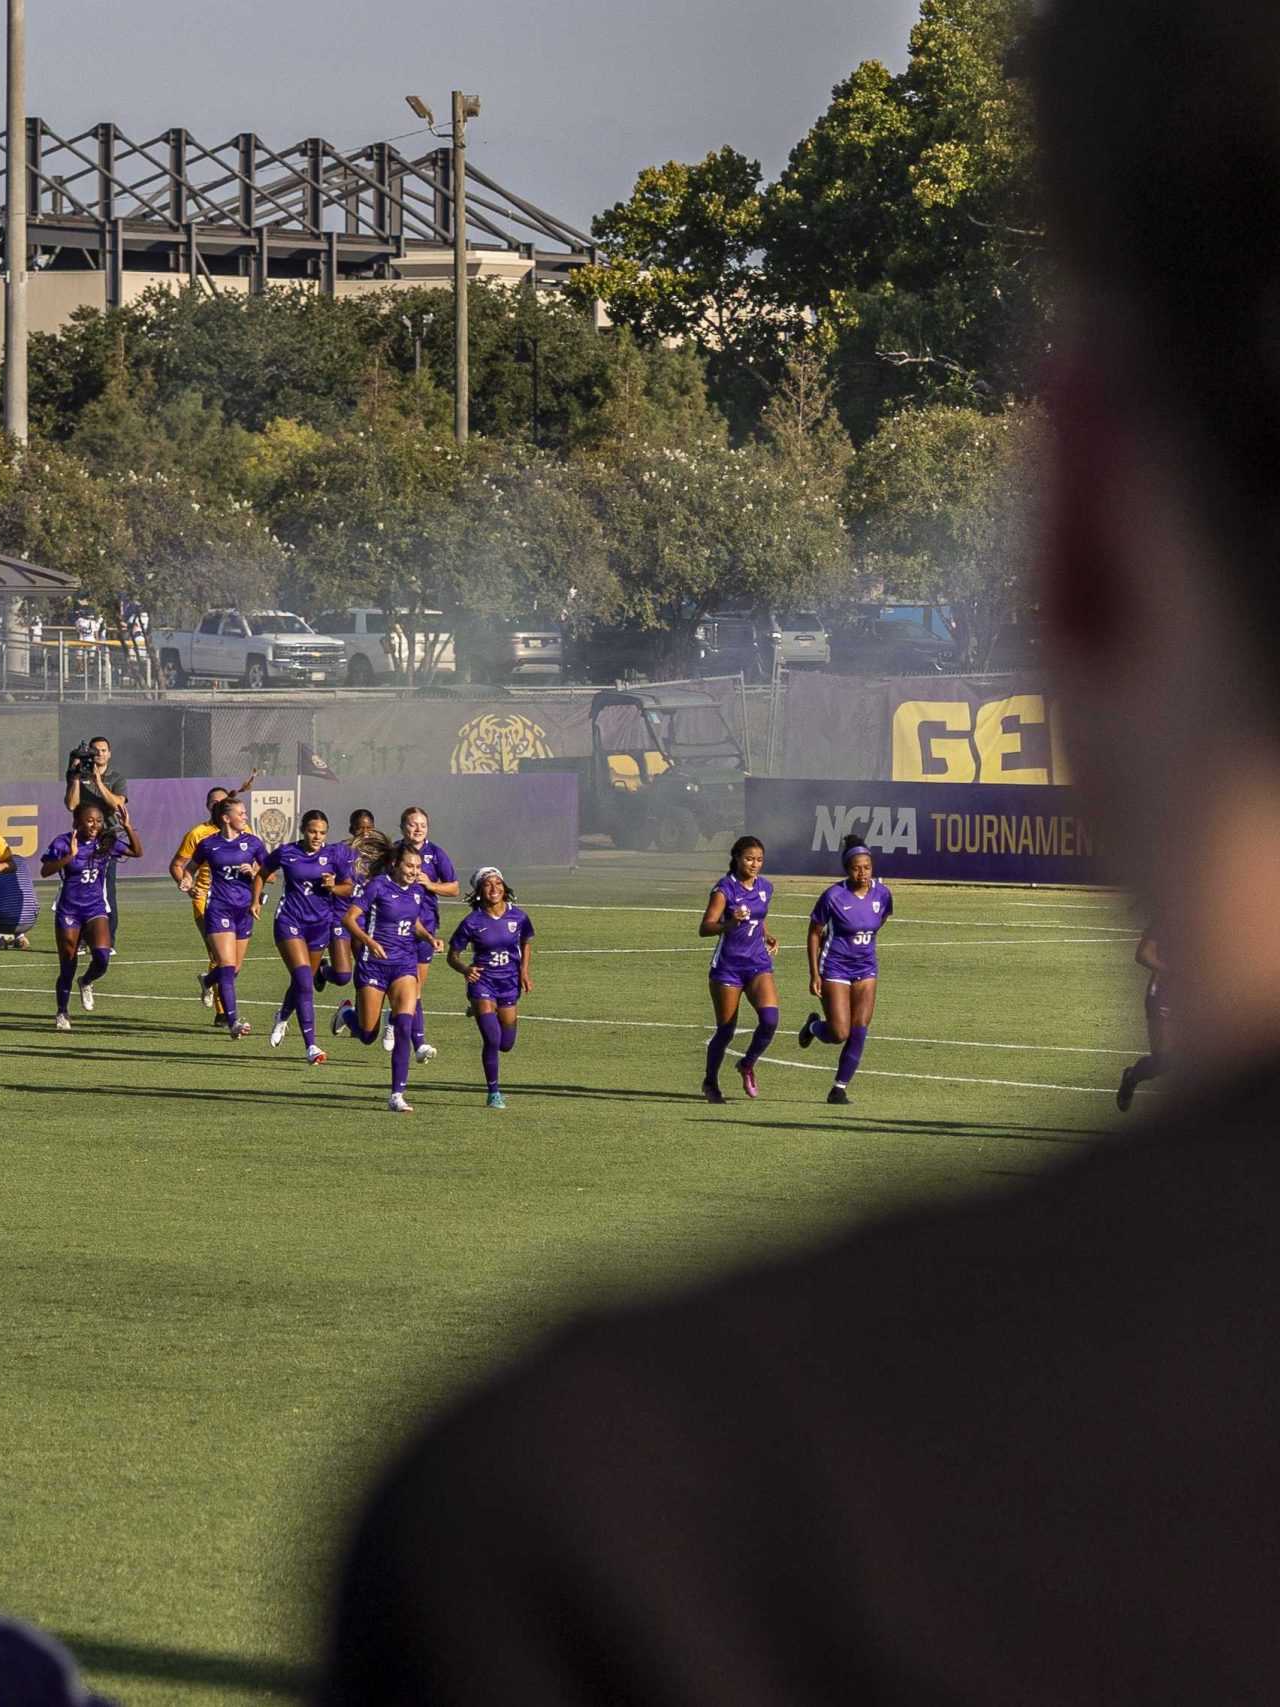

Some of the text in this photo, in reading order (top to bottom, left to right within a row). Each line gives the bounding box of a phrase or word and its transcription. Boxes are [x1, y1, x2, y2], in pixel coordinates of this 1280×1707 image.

[893, 694, 1072, 786] GE
[262, 796, 283, 805] LSU
[811, 805, 1096, 856] NCAA TOURNAMEN
[80, 868, 99, 884] 33
[223, 865, 241, 880] 27
[398, 920, 411, 936] 12
[747, 920, 759, 937] 7
